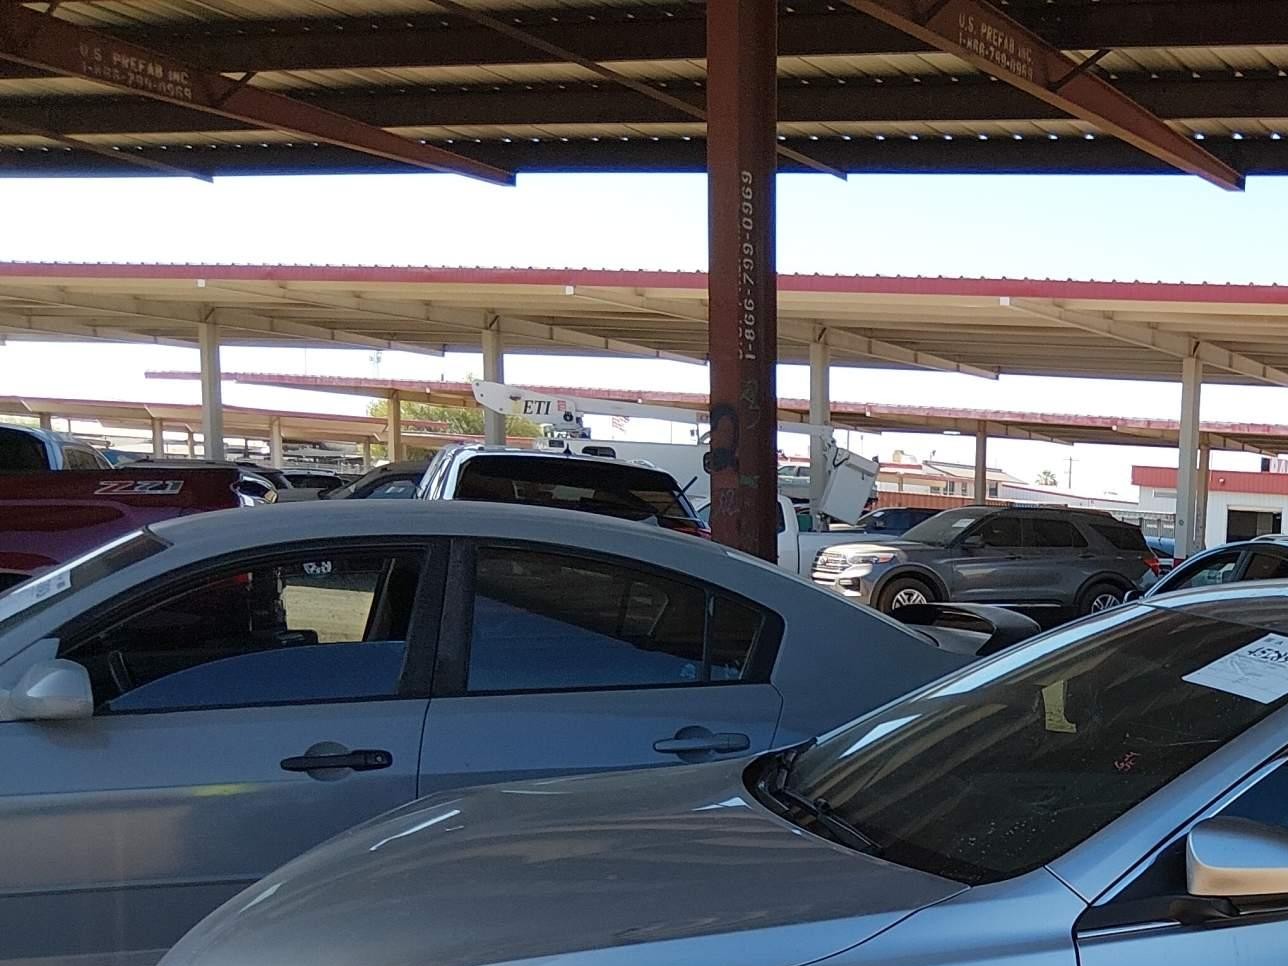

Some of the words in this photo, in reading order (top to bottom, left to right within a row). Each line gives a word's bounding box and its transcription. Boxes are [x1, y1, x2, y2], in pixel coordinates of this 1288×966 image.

[981, 22, 1015, 54] PREFAB
[741, 170, 757, 361] 1-866-799-0969
[523, 400, 552, 415] ETI
[94, 480, 184, 495] Z71
